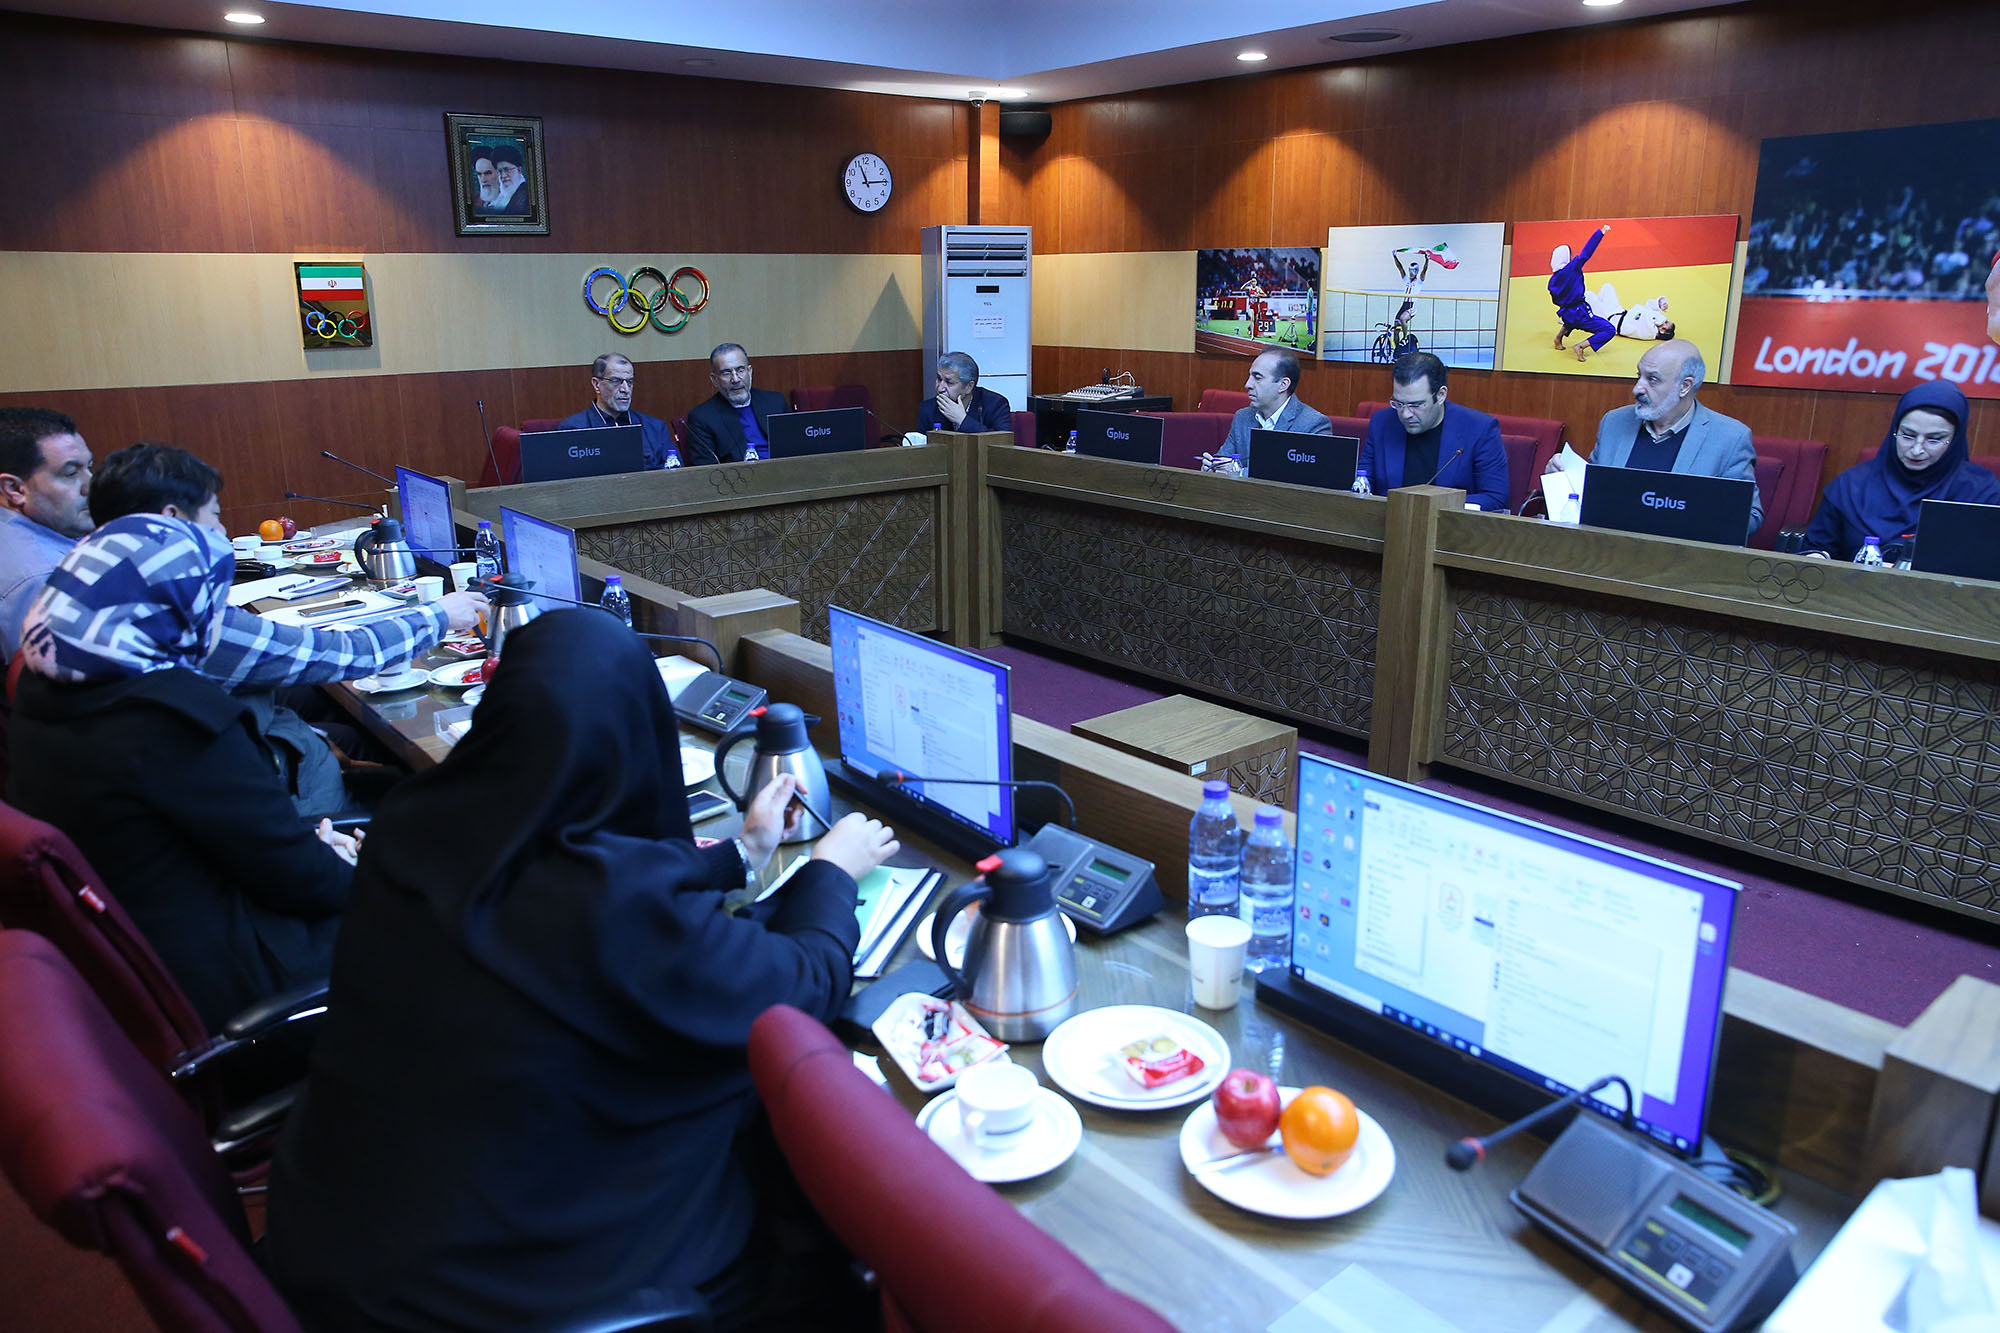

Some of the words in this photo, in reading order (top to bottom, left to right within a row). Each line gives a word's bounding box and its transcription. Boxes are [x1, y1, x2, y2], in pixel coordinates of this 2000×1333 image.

[862, 157, 869, 165] 12
[1754, 336, 1907, 379] London
[805, 426, 832, 438] Gplus
[1106, 427, 1130, 441] Gplus
[568, 445, 601, 459] Gplus
[1287, 448, 1316, 463] Gplus
[1641, 490, 1686, 511] Gplus
